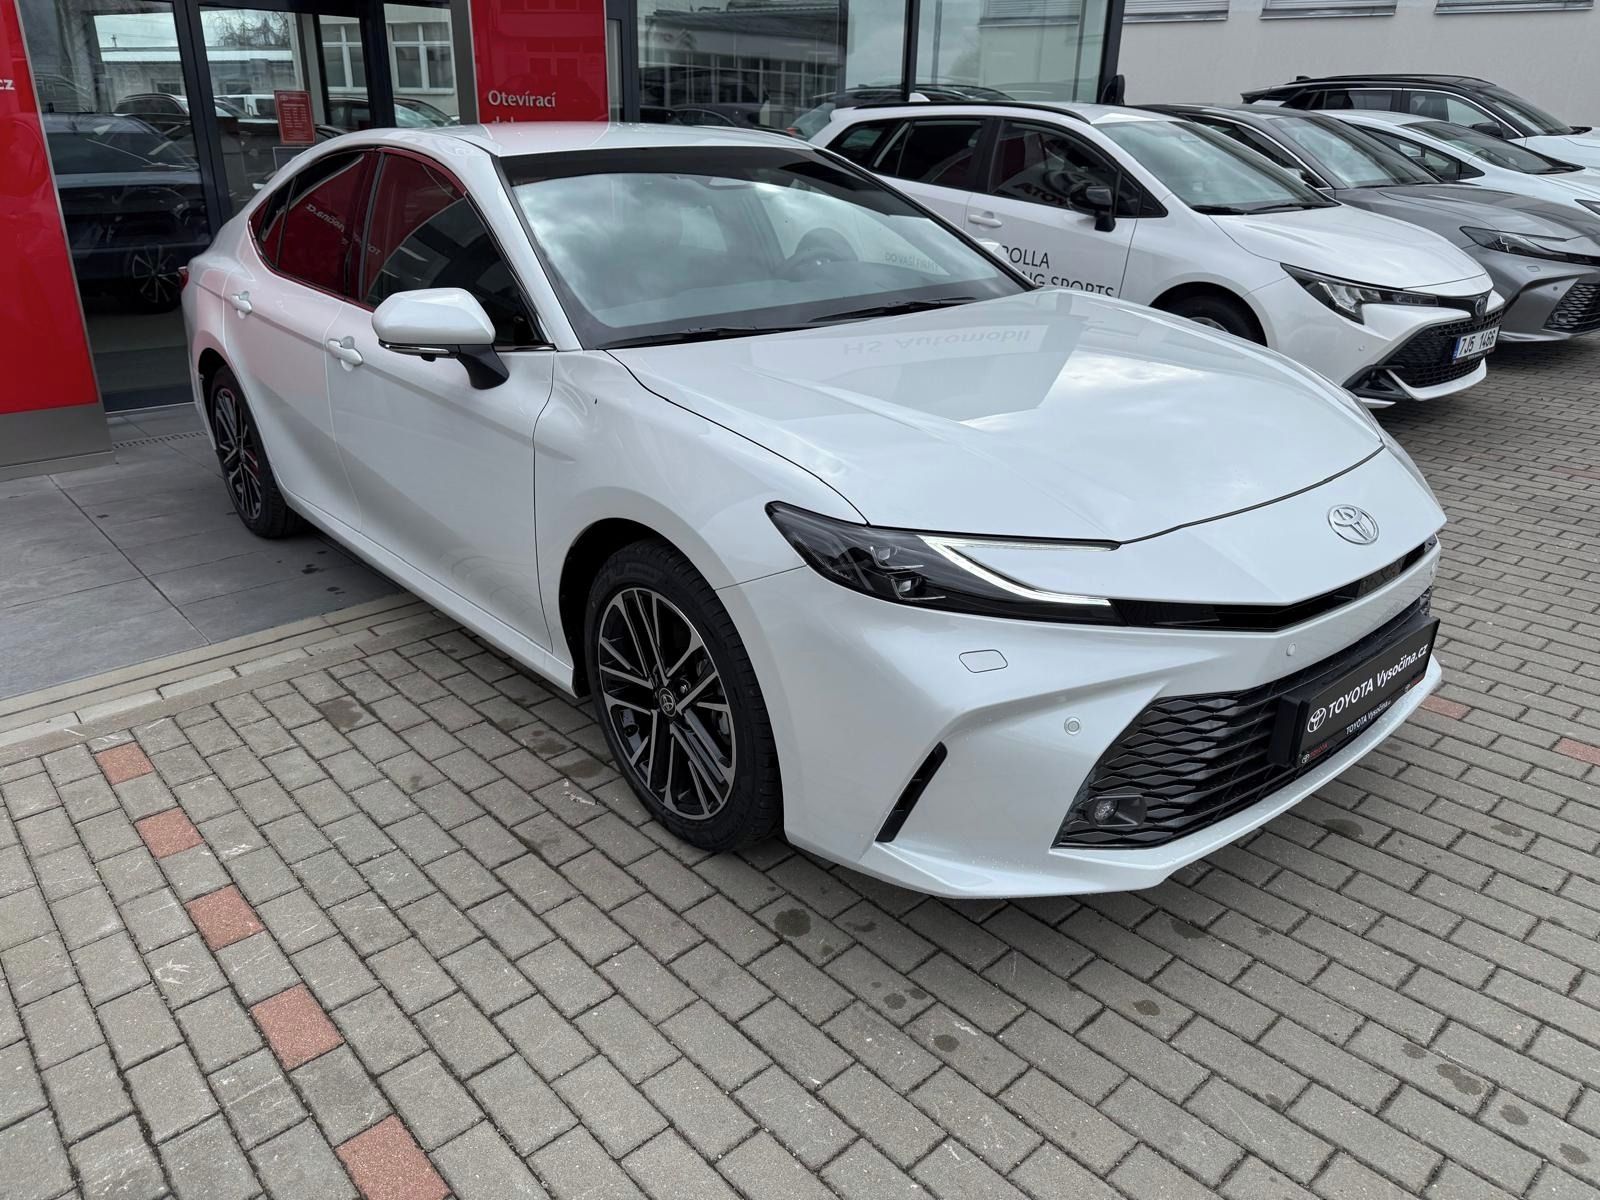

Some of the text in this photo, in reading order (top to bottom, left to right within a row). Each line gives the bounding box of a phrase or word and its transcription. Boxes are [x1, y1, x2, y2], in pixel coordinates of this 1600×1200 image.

[488, 85, 556, 107] Otevírací
[1459, 335, 1475, 355] 7J5
[1328, 643, 1428, 718] TOYOTA Vysočina.cz
